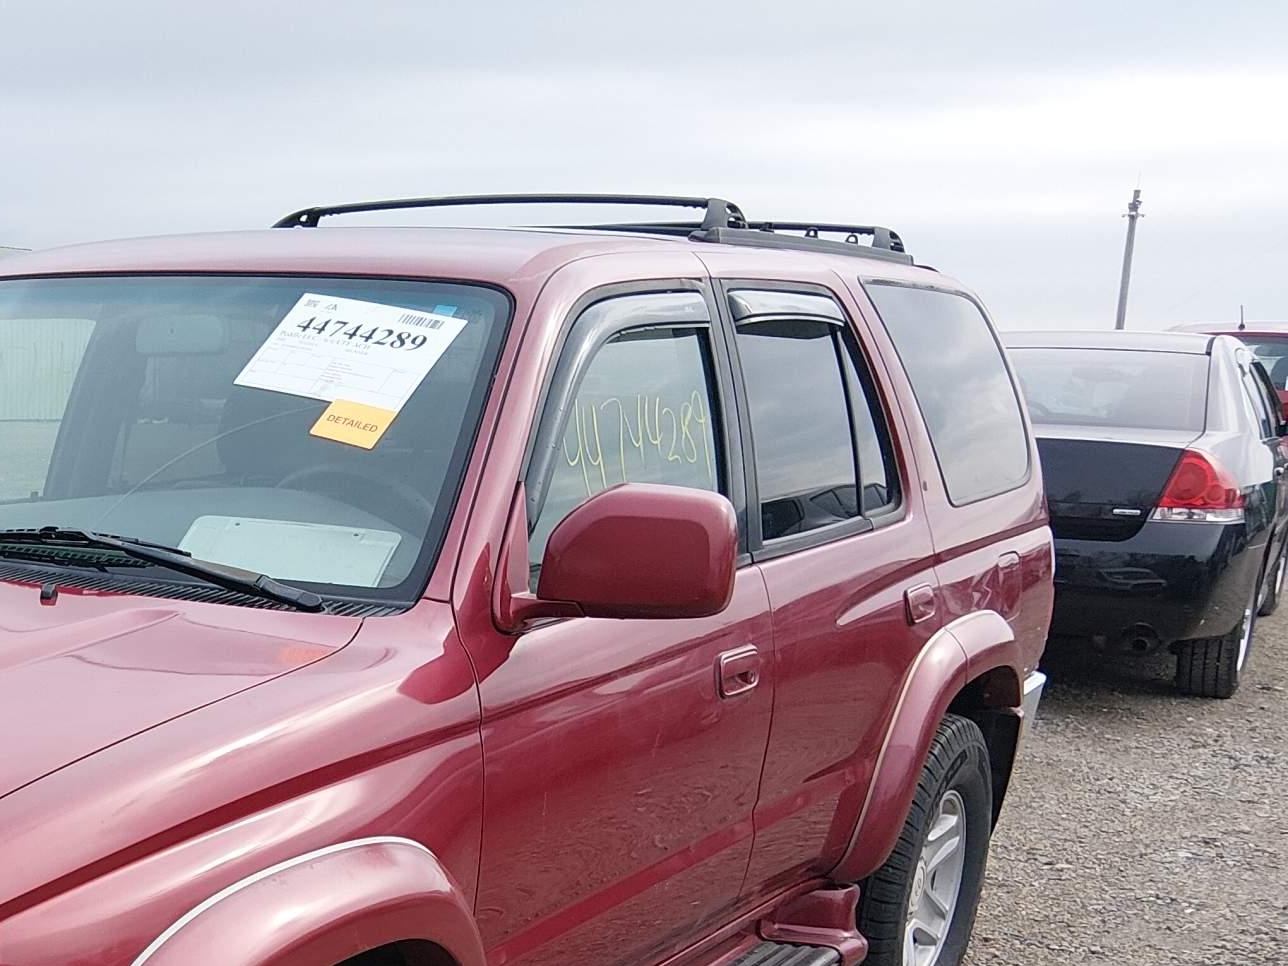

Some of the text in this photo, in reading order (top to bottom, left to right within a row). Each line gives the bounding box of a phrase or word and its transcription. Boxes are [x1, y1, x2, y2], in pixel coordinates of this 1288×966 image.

[295, 316, 428, 351] 44744289
[326, 413, 379, 434] DETAILED
[563, 390, 712, 497] 44744289
